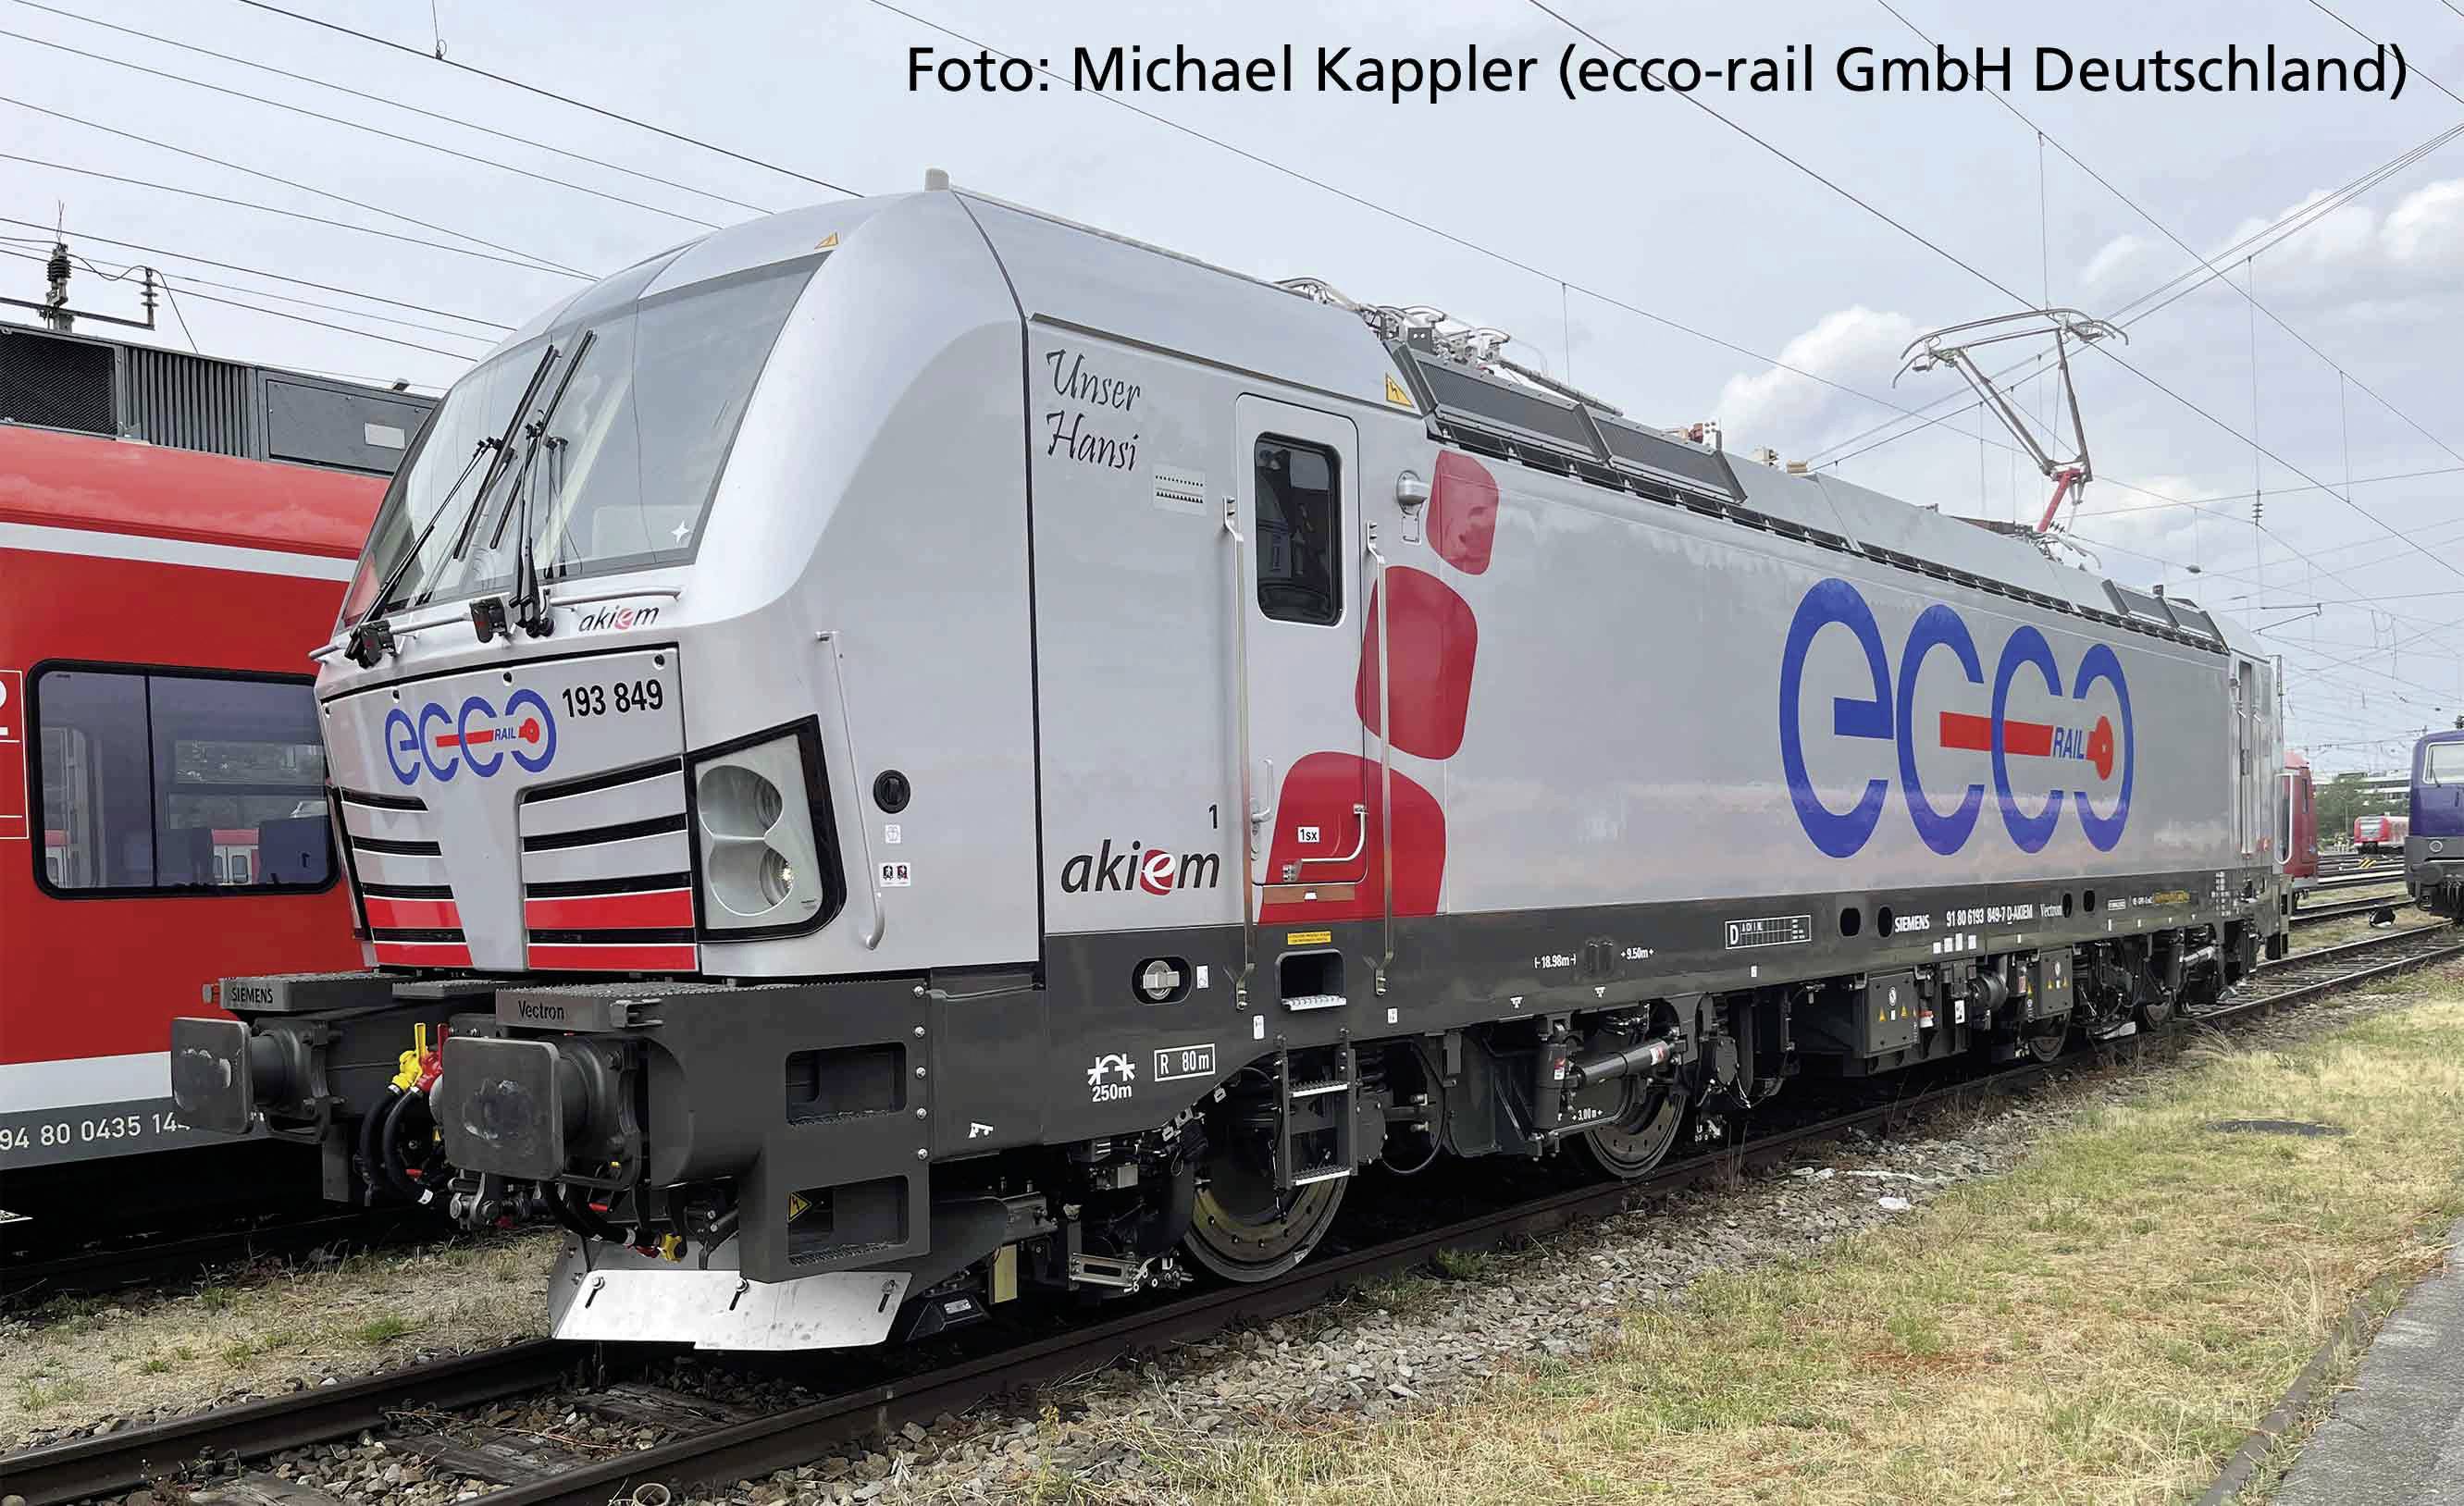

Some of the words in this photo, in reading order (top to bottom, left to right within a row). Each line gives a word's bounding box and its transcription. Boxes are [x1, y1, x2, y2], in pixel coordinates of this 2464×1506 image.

[1046, 349, 1141, 412] Unser
[1046, 409, 1139, 471] Hansi
[577, 604, 660, 633] akiem
[562, 685, 606, 718] 193
[613, 679, 664, 714] 849
[494, 727, 517, 741] RAIL
[2052, 726, 2086, 759] RAIL
[1208, 805, 1218, 830] 1
[1300, 829, 1318, 841] 1sx
[1060, 839, 1220, 895] akiem
[1894, 914, 1930, 933] SIEMENS
[1946, 910, 1955, 927] 91
[1957, 909, 1966, 926] 80
[1967, 907, 1984, 925] 6193
[1987, 906, 2006, 923] 849-7
[2007, 904, 2033, 924] D-AKIEM
[1729, 924, 1740, 945] D
[1541, 954, 1570, 969] 18.98m
[1626, 947, 1649, 960] 9.50m
[230, 986, 274, 1004] SIEMENS
[518, 1000, 565, 1022] Vectron
[1160, 1054, 1170, 1075] R
[1092, 1083, 1133, 1102] 250m
[0, 1128, 30, 1151] 94
[40, 1123, 70, 1146] 80
[80, 1116, 142, 1142] 0435
[152, 1112, 192, 1133] 14
